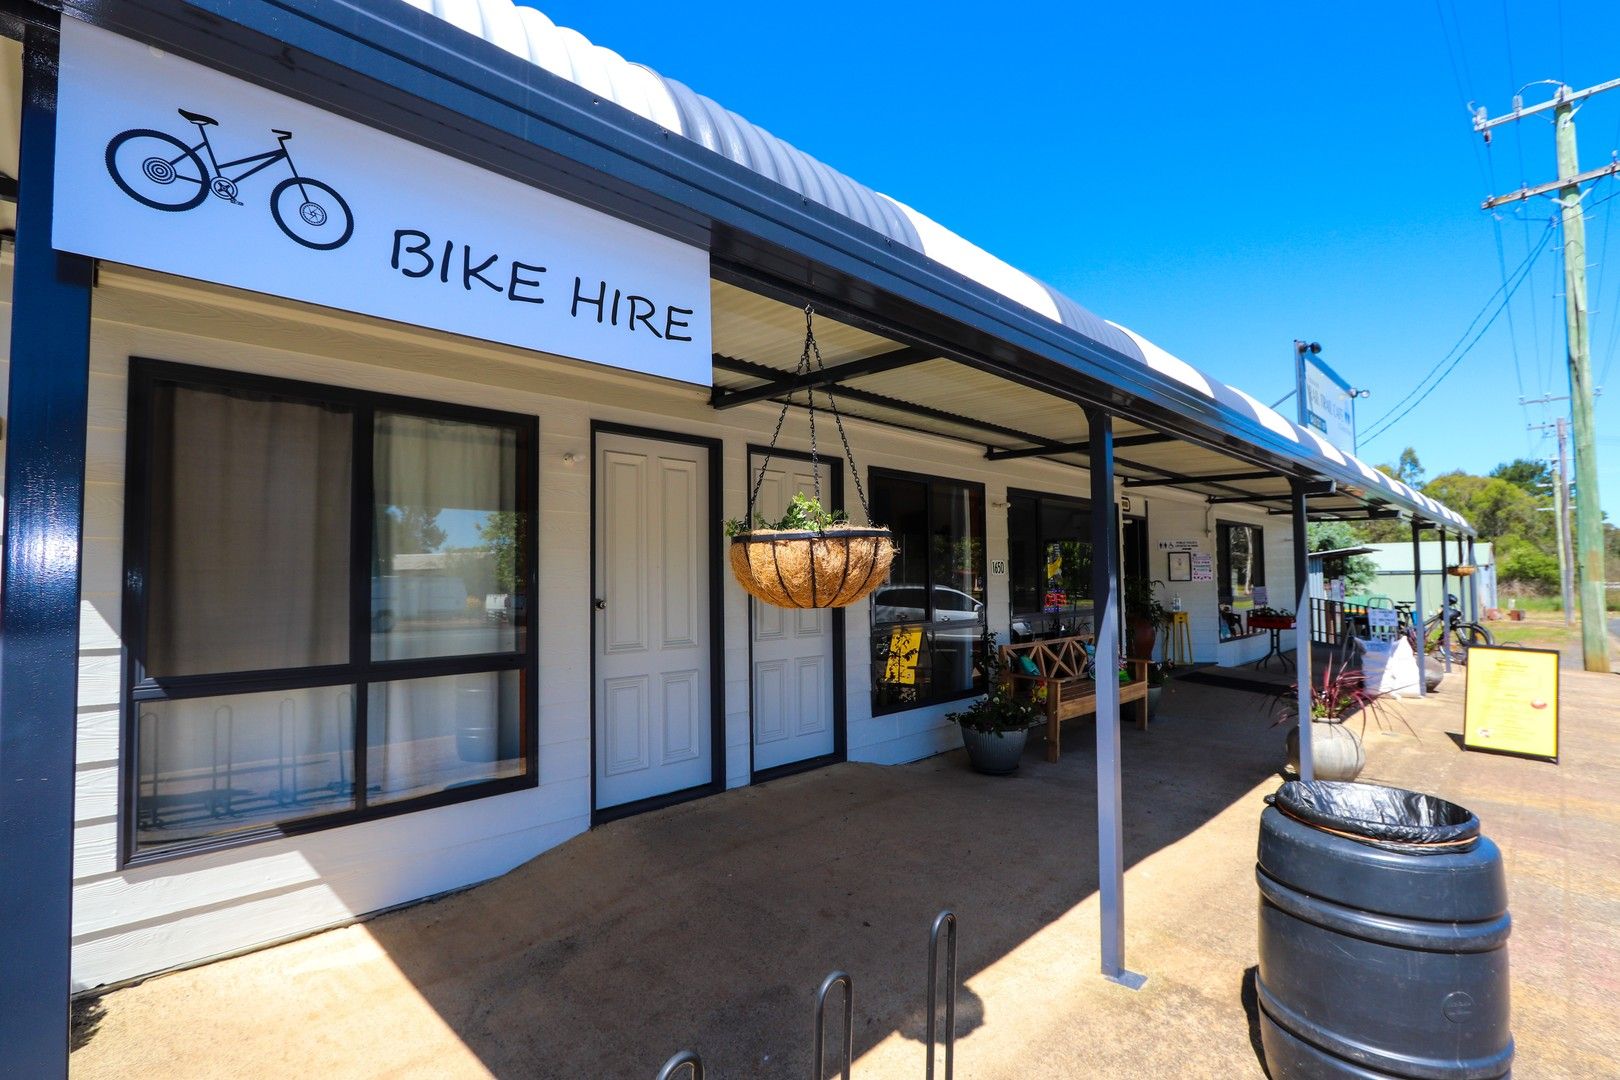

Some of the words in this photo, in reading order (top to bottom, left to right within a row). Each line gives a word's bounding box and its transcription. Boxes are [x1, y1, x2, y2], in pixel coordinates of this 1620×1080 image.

[390, 229, 547, 305] BIKE
[571, 276, 694, 342] HIRE
[992, 560, 1005, 574] 1650
